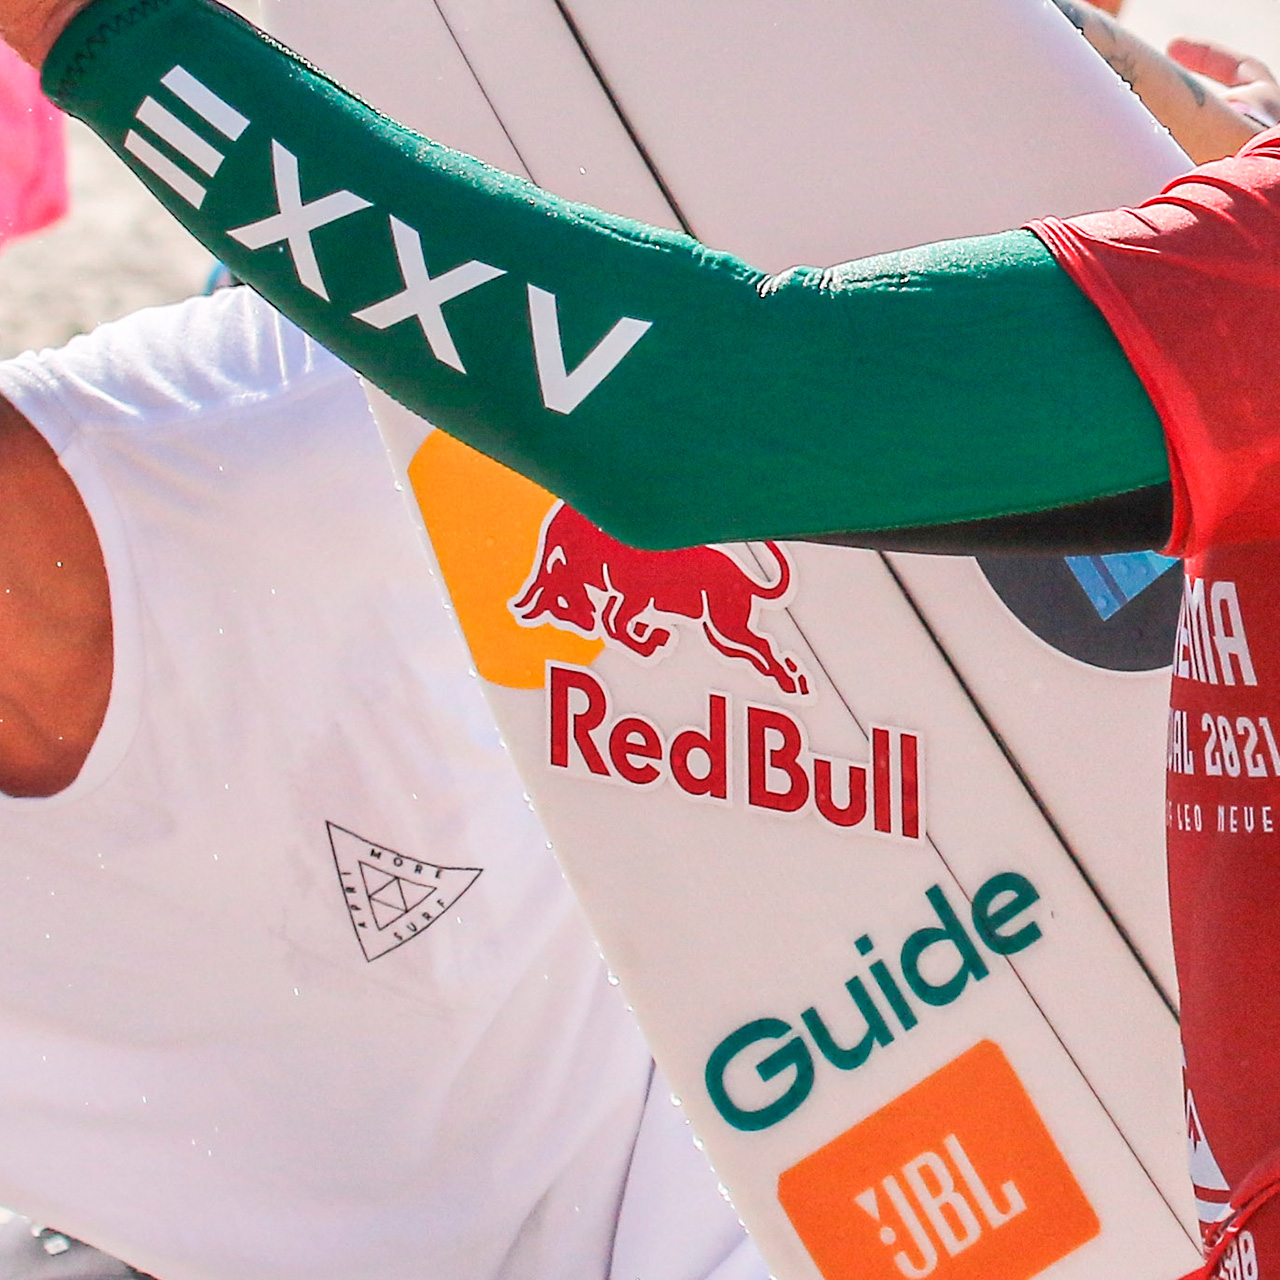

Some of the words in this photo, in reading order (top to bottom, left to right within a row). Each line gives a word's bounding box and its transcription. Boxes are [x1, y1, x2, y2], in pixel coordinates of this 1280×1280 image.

[1172, 573, 1258, 686] EMA
[550, 665, 728, 801] Red
[746, 704, 921, 841] Bull
[369, 847, 445, 880] MORE
[1177, 803, 1203, 833] LEO
[392, 898, 446, 942] SURF
[703, 871, 1042, 1133] Guide
[881, 1133, 1028, 1280] JBL
